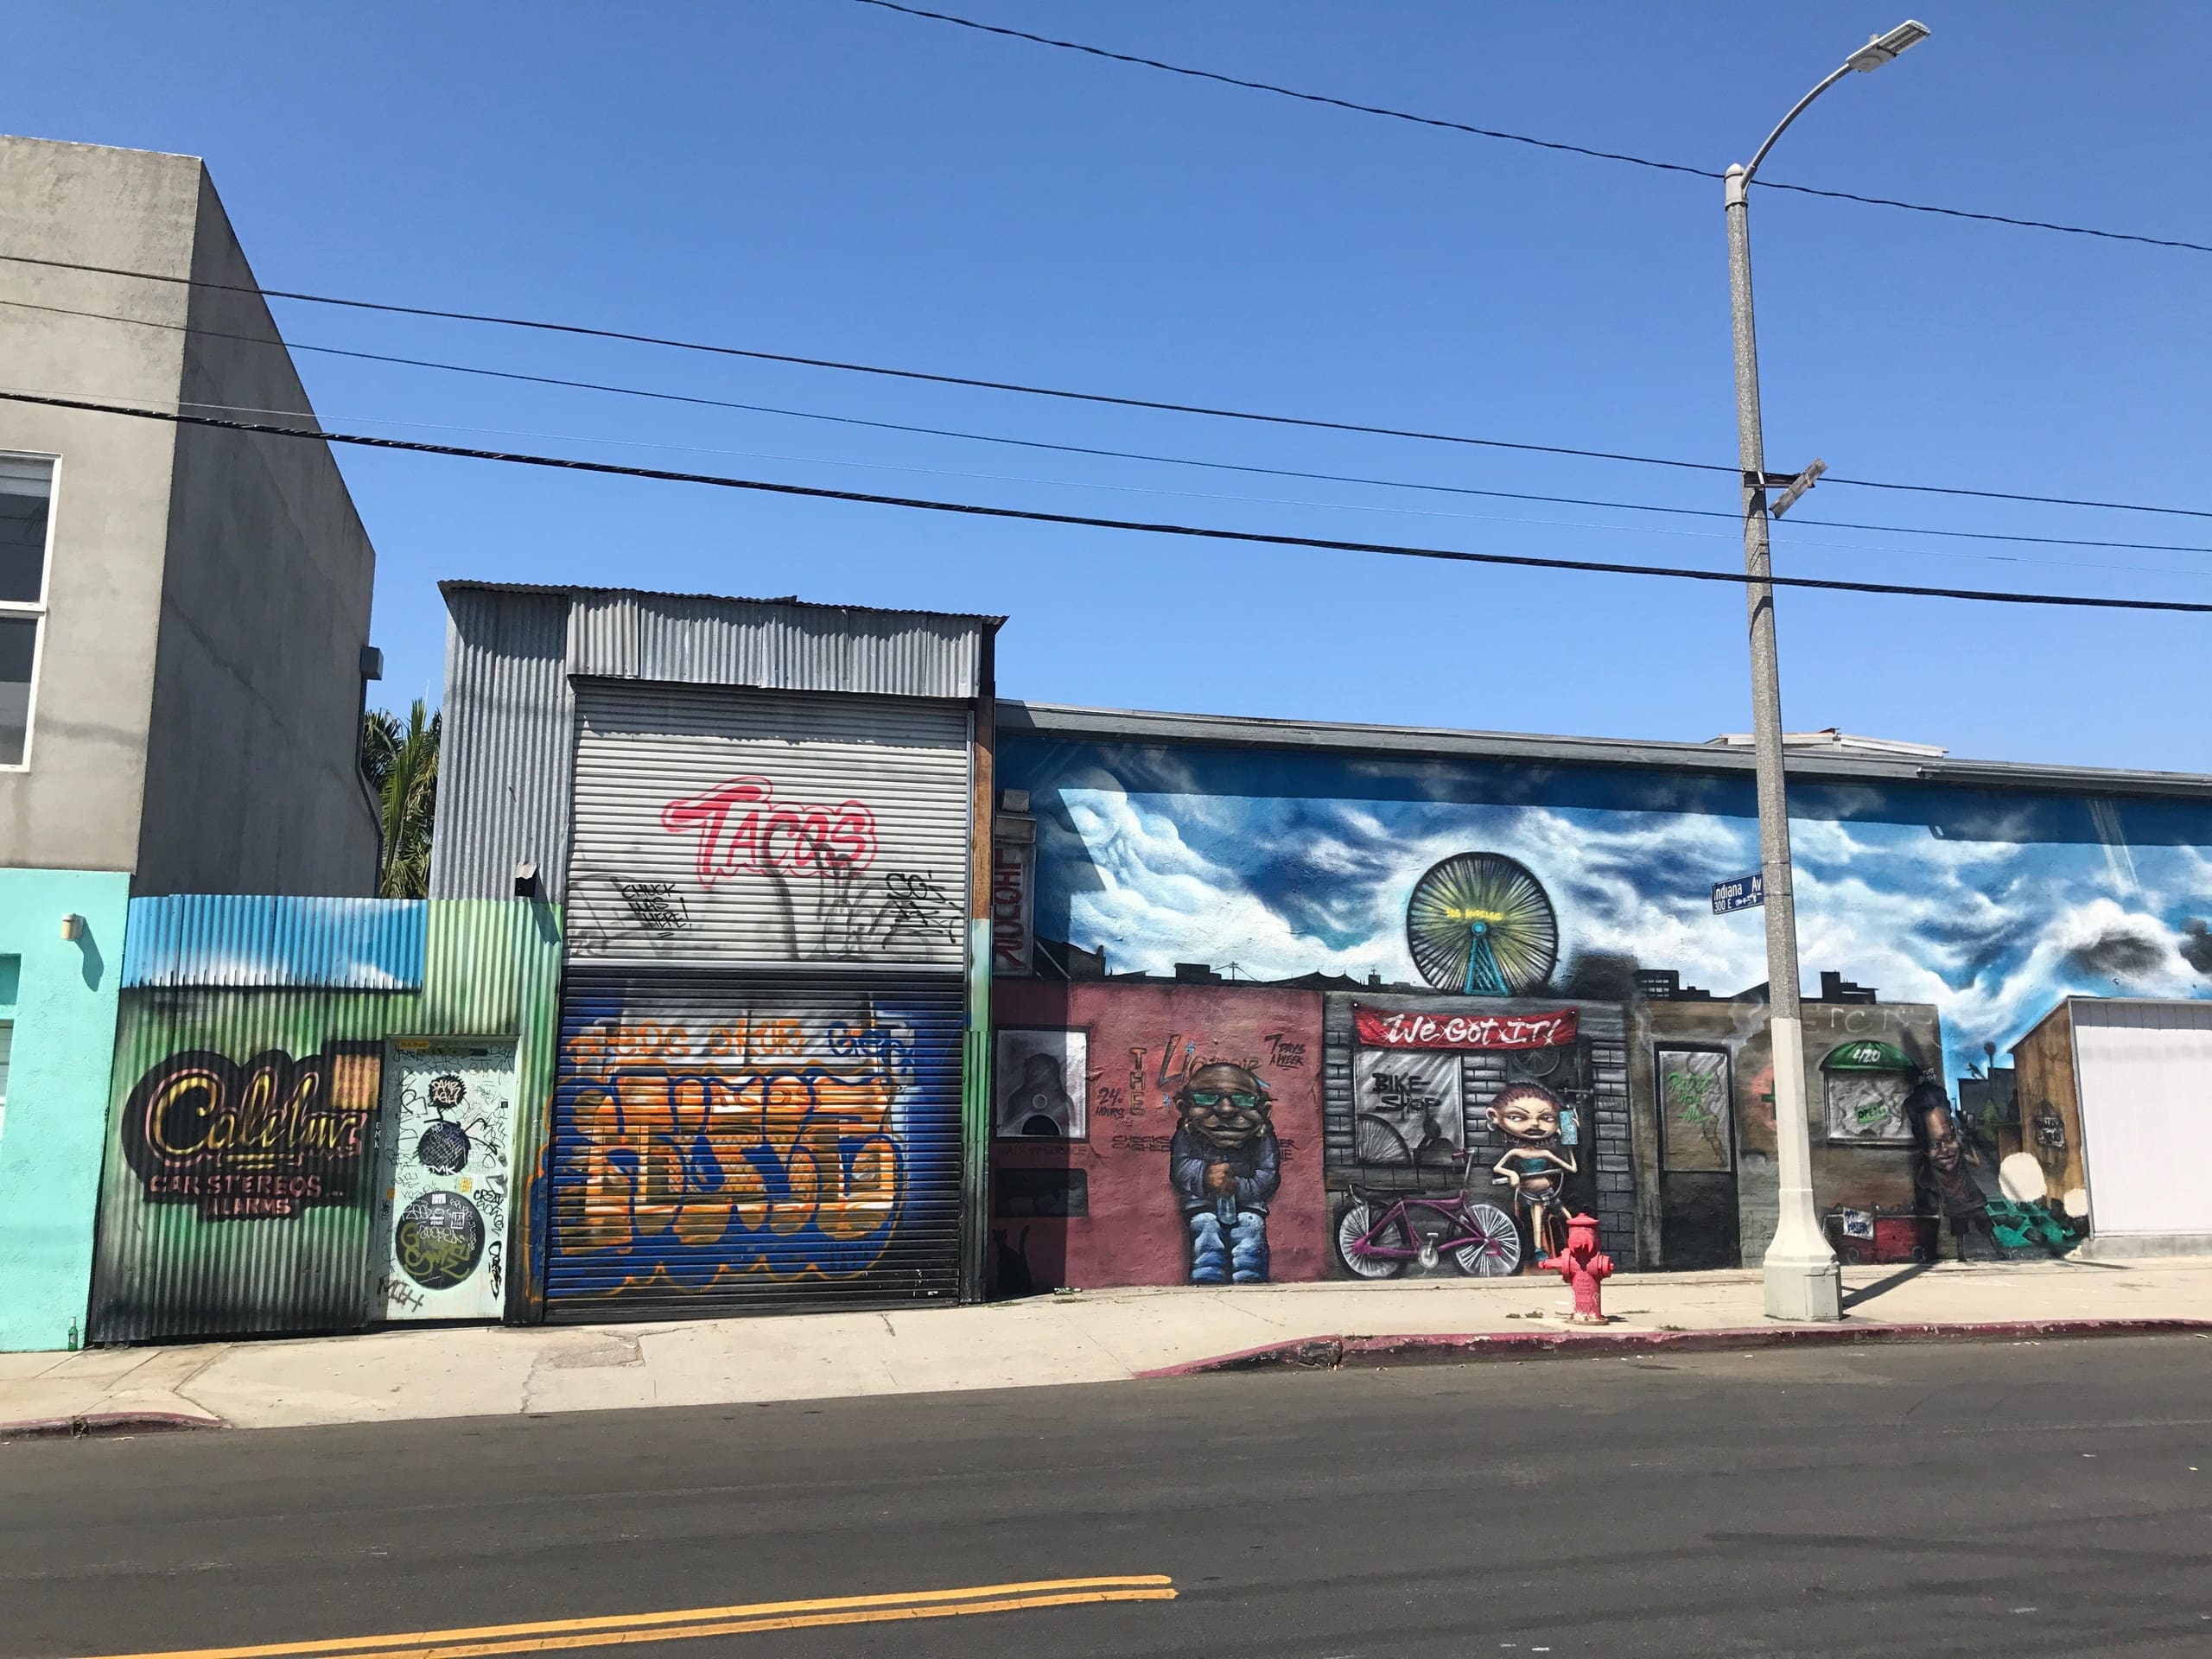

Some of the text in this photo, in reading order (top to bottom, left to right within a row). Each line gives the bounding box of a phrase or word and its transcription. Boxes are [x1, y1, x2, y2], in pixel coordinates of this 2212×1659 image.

[620, 884, 684, 899] CHUCK
[1713, 883, 1743, 901] Indiana
[1751, 876, 1762, 893] Av
[628, 897, 670, 914] WAS
[1714, 899, 1726, 912] 300
[1382, 1014, 1440, 1043] We
[1444, 1018, 1499, 1046] Got
[1264, 1033, 1284, 1055] 7
[1853, 1048, 1881, 1064] 420
[1128, 1047, 1147, 1116] THE
[1371, 1072, 1432, 1095] BIKE
[149, 1175, 200, 1195] CAR
[207, 1198, 291, 1216] ALARMS
